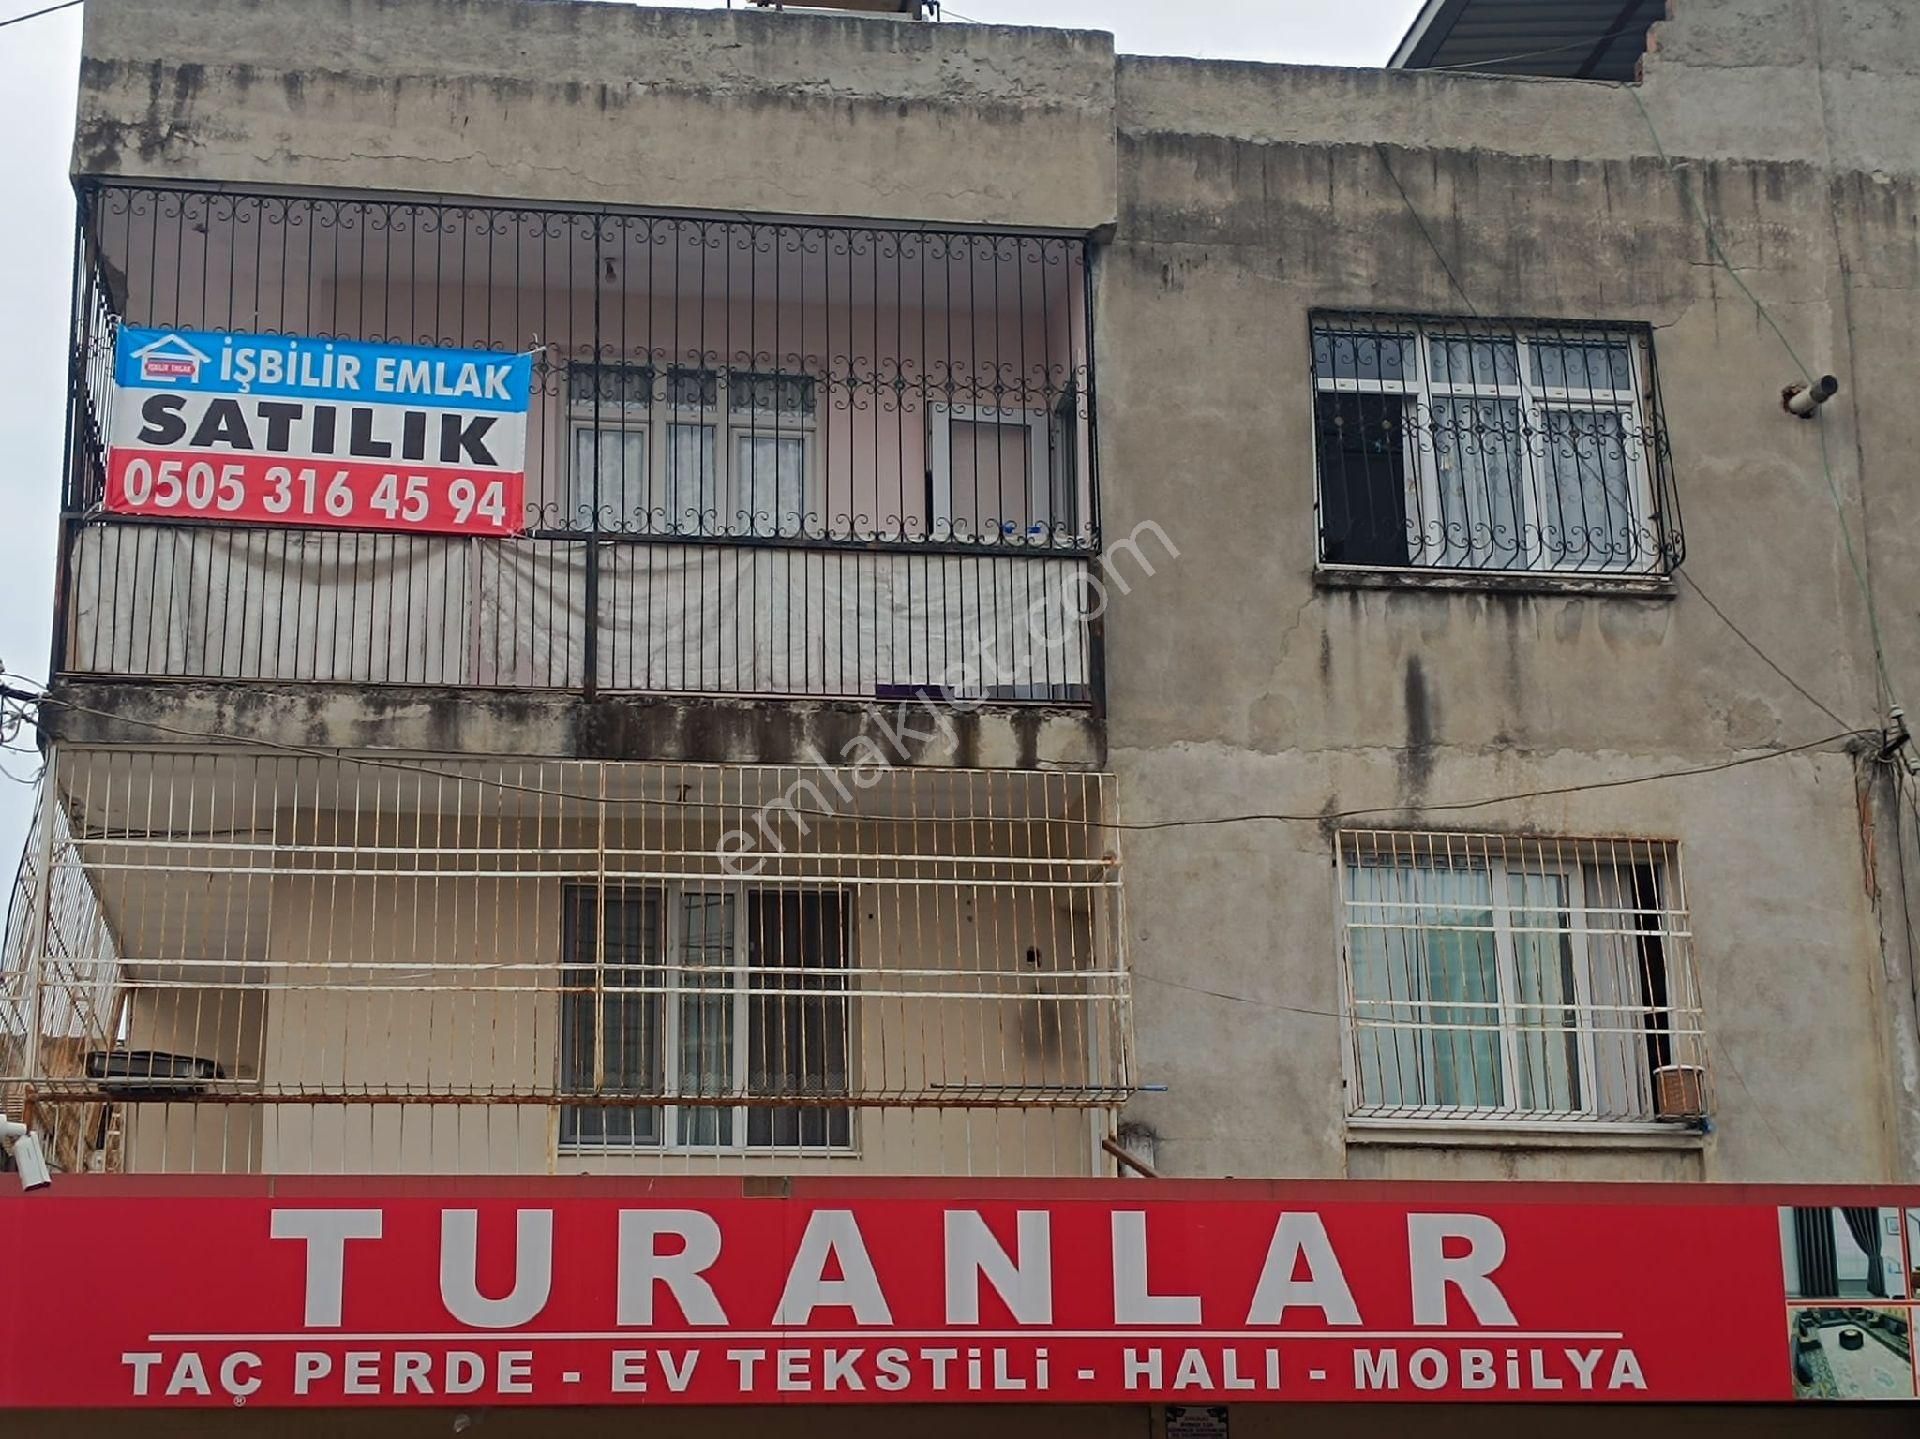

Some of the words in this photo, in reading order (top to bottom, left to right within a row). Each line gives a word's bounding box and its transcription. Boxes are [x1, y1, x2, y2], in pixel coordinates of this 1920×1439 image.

[220, 336, 361, 393] İŞBİLİR
[375, 357, 512, 400] EMLAK
[137, 393, 499, 467] SATILIK
[123, 458, 246, 512] 0505
[262, 466, 354, 518] 316
[369, 473, 430, 523] 45
[447, 478, 506, 527] 94
[271, 1208, 1519, 1328] TURANLAR
[294, 1351, 534, 1395] PERDE
[562, 1371, 581, 1383] -
[611, 1350, 700, 1393] EV
[1077, 1369, 1095, 1380] -
[1123, 1348, 1280, 1390] HALI
[1309, 1370, 1326, 1380] -
